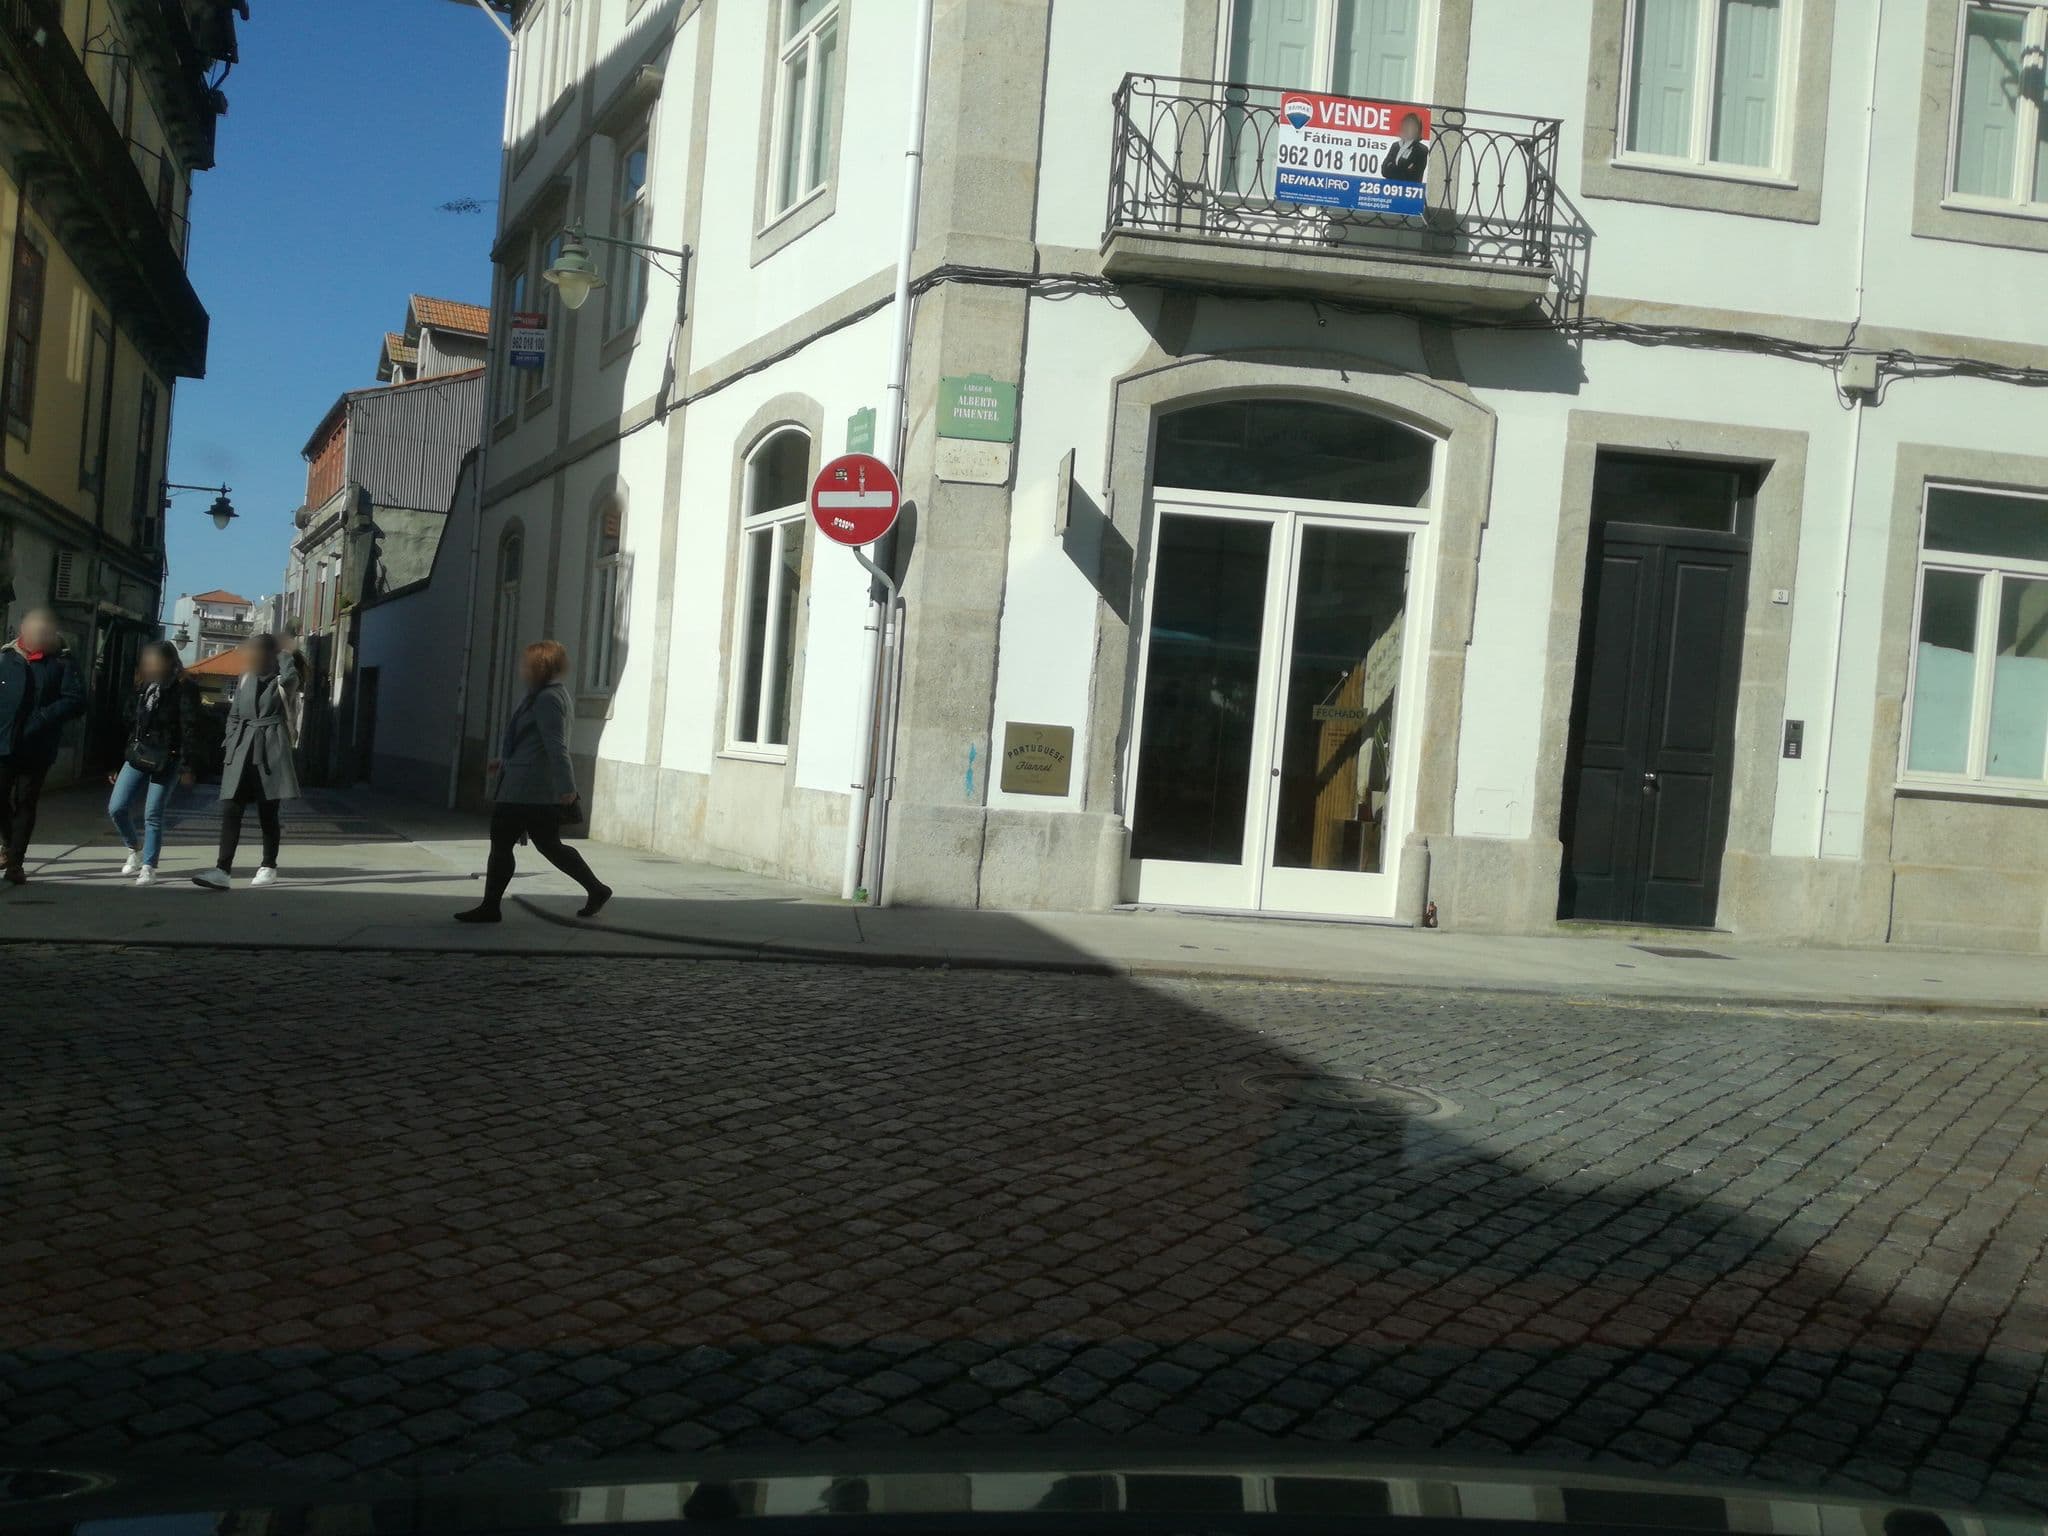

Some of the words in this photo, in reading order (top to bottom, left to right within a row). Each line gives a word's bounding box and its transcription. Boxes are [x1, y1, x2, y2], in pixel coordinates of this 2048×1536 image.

[1319, 101, 1391, 131] VENDE
[1304, 131, 1352, 147] Fátima
[1357, 137, 1388, 151] Dias
[1279, 144, 1308, 167] 962
[1314, 149, 1343, 171] 018
[1350, 152, 1378, 174] 100
[1359, 182, 1380, 194] 226
[1383, 184, 1402, 196] 091
[1405, 187, 1424, 199] 571
[959, 395, 998, 408] ALBERTO
[953, 407, 999, 421] PIMENTEL
[1777, 591, 1784, 601] 3
[1316, 708, 1365, 720] FECHADO
[1007, 743, 1065, 763] PORTUGUESE
